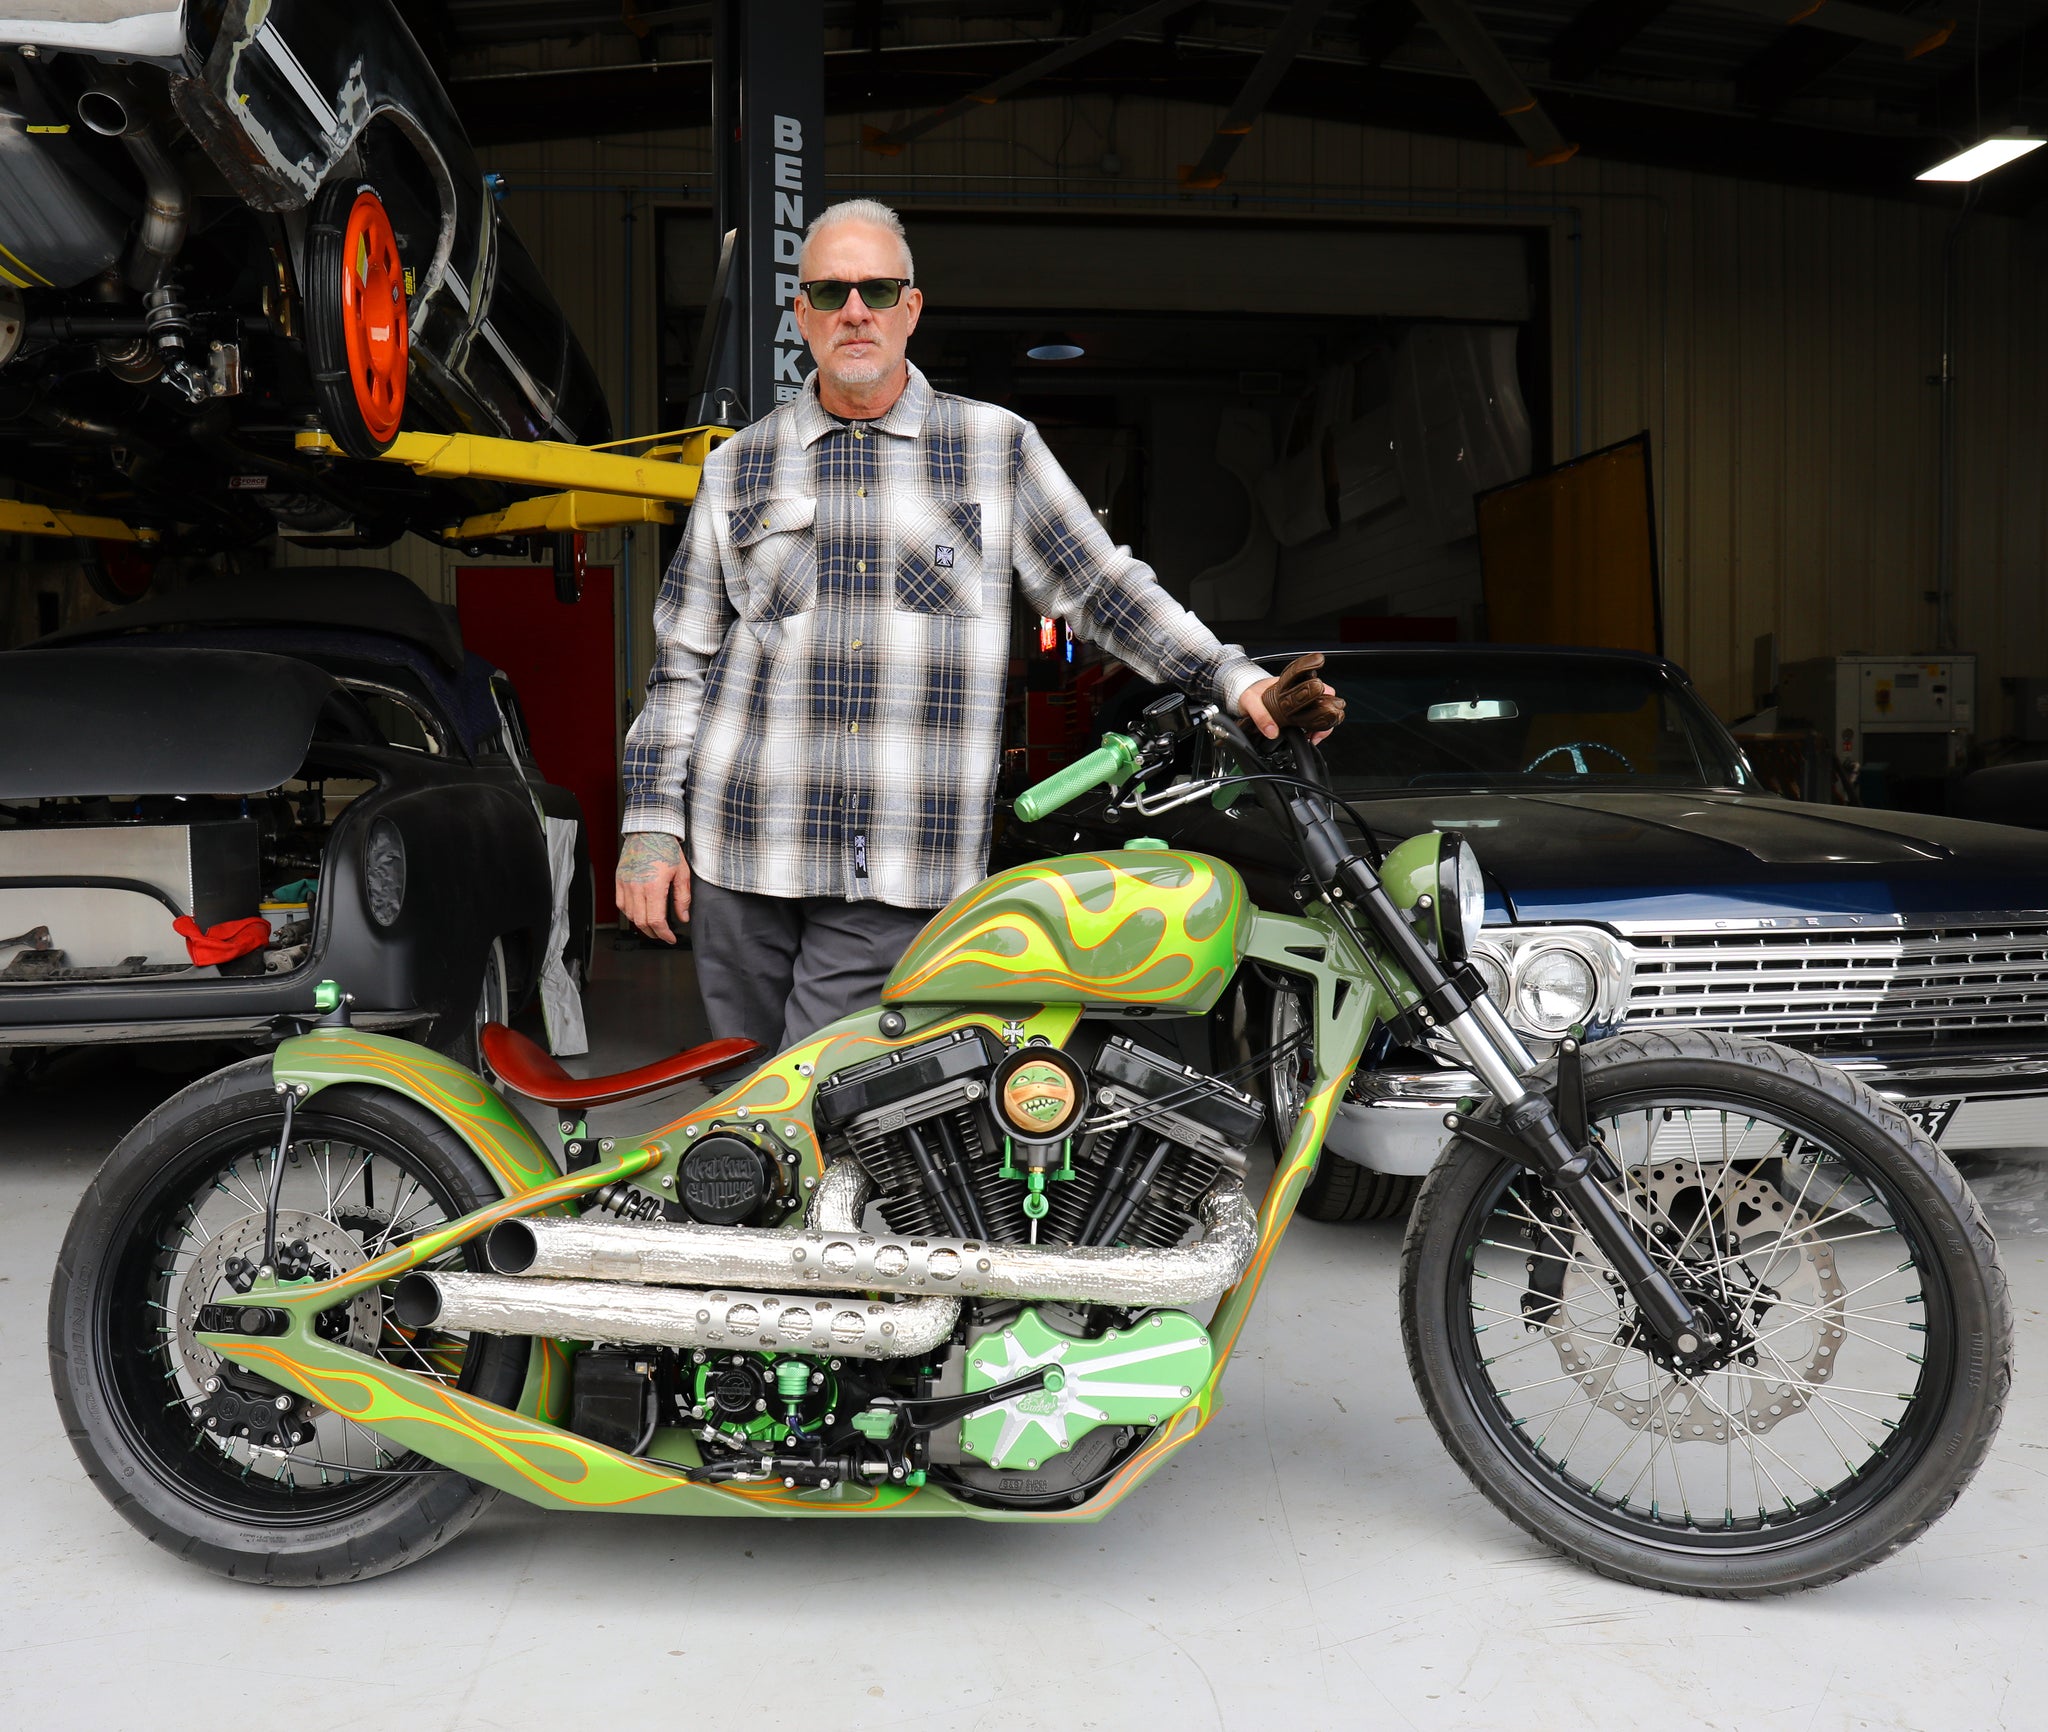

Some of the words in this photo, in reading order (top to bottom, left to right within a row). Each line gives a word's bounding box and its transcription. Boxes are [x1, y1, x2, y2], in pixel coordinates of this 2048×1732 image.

[773, 115, 804, 383] BENDPAK
[882, 1113, 903, 1130] S&S
[1172, 1127, 1196, 1144] S&S
